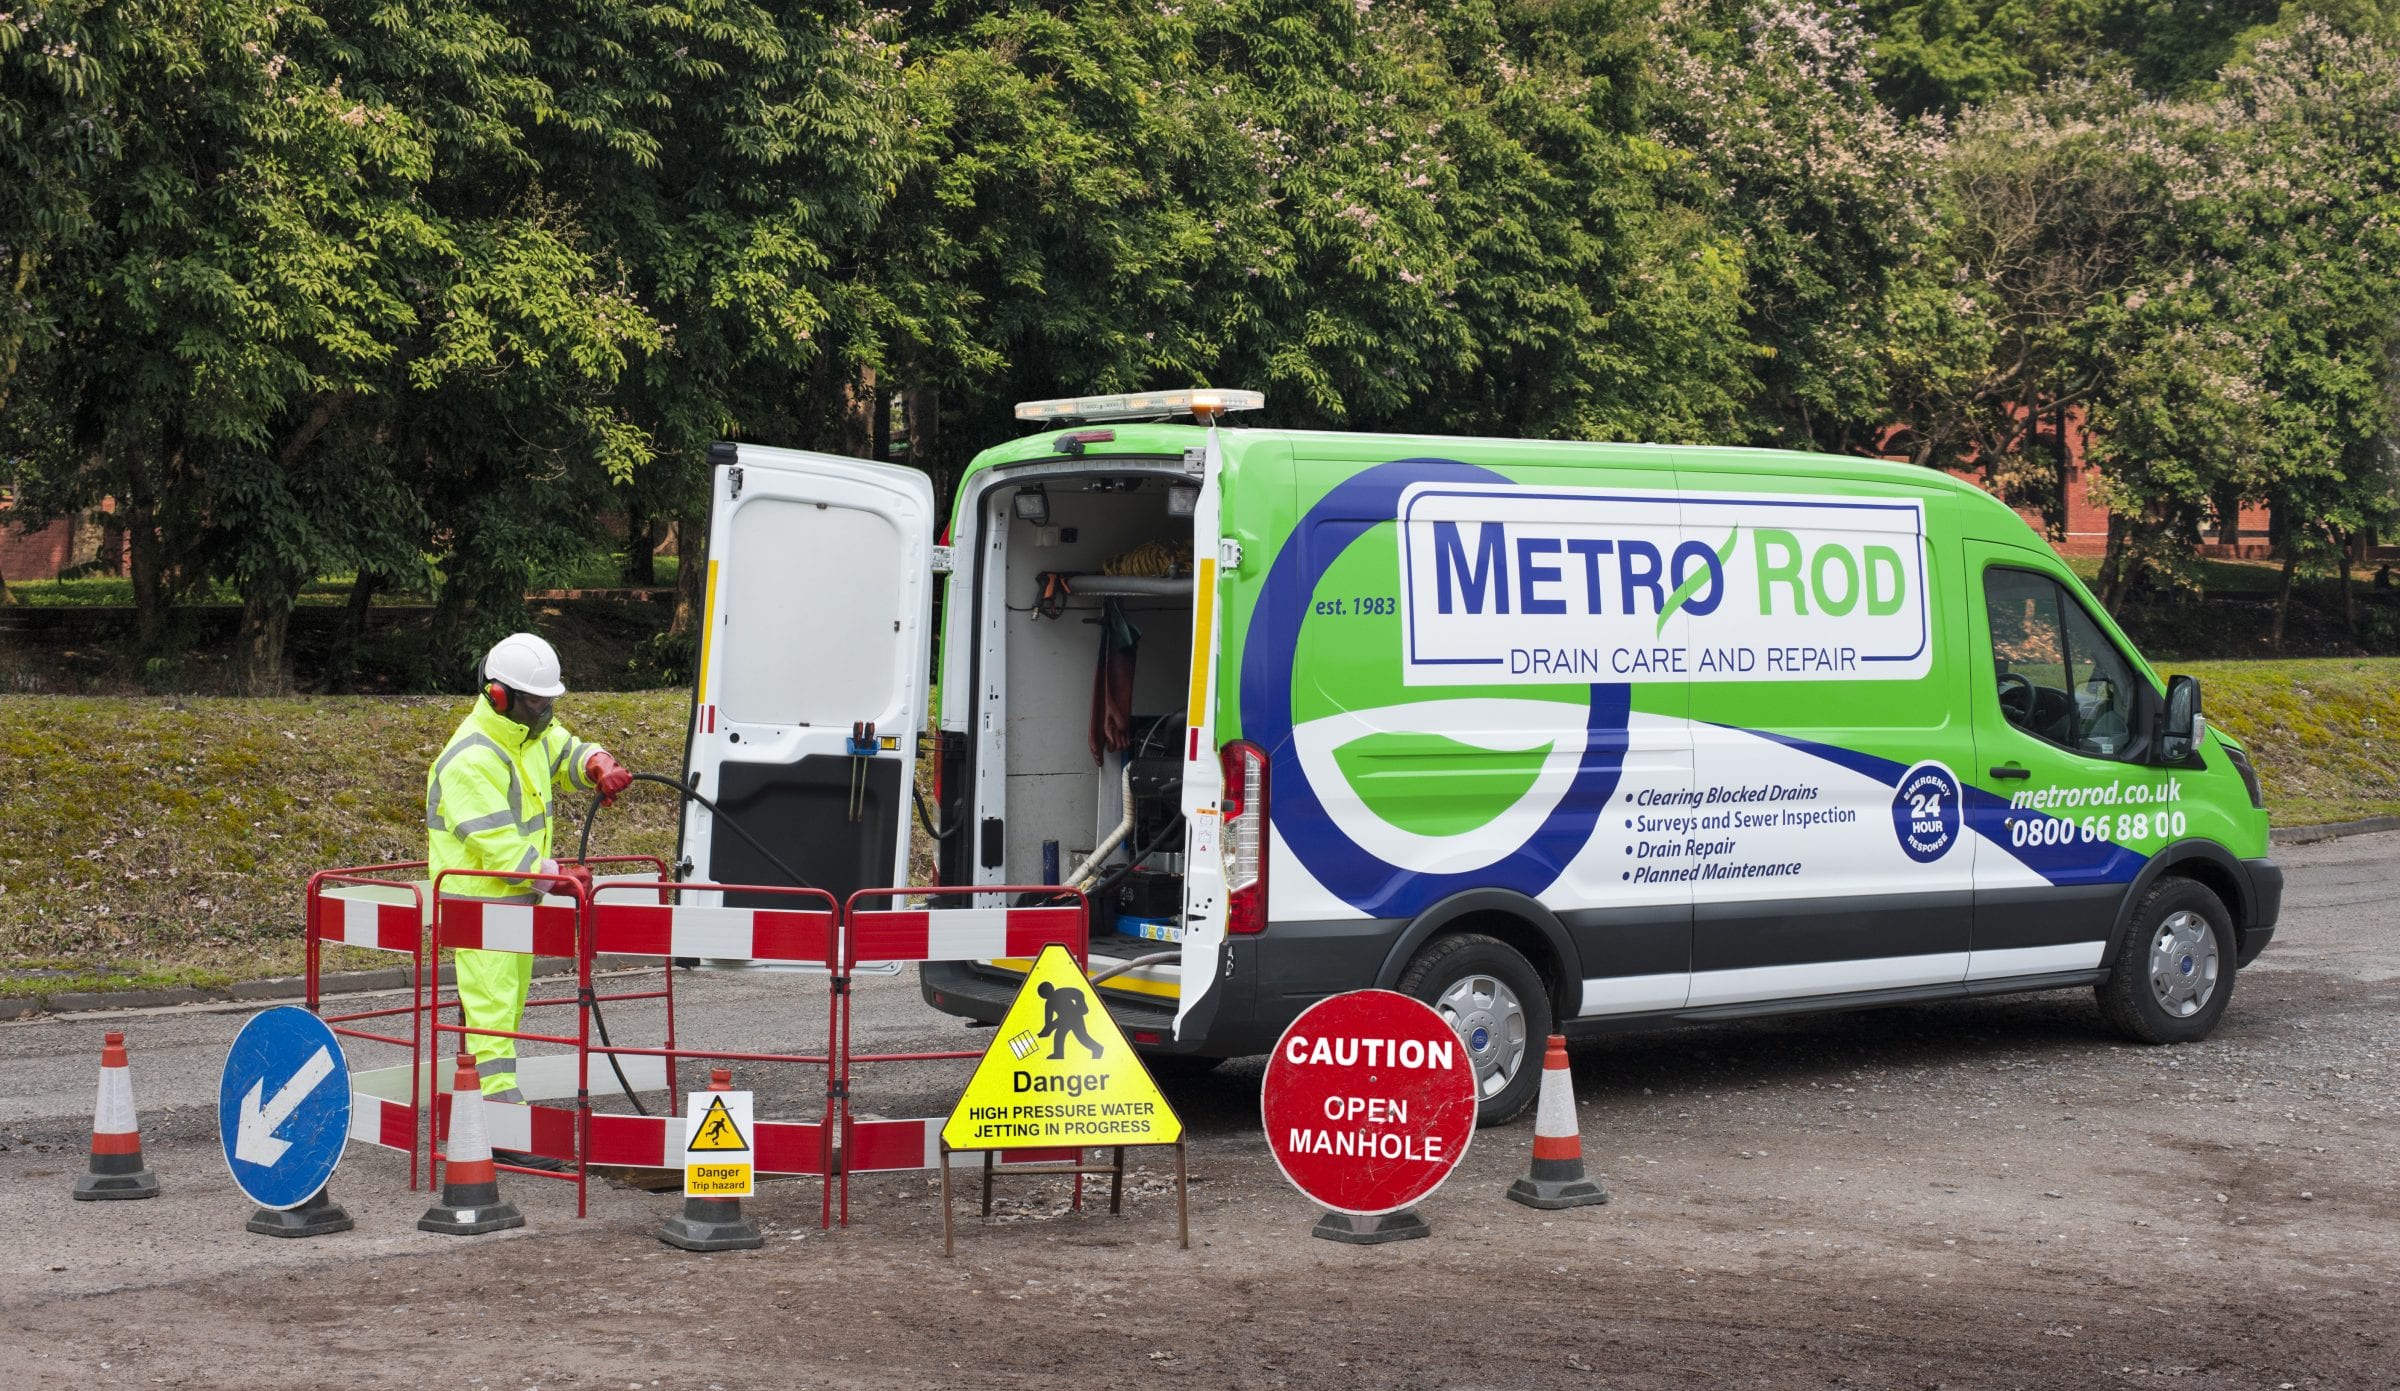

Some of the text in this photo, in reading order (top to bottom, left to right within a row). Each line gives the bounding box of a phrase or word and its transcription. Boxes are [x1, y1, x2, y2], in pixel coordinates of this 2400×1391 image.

[1433, 521, 1906, 617] METRO ROD
[1316, 597, 1396, 615] est. 1983
[1511, 647, 1857, 675] DRAIN CARE AND REPAIR
[1638, 784, 1818, 809] Clearing Blocked Drains
[1903, 776, 1951, 800] EMERGENCY
[2010, 777, 2182, 810] metrorod.co.uk
[1910, 794, 1940, 818] 24
[1637, 806, 1856, 835] Surveys and Sewer Inspection
[1912, 821, 1944, 834] HOUR
[2012, 811, 2186, 848] 0800 66 88 00
[1637, 837, 1736, 860] Drain Repair
[1908, 833, 1949, 853] RESPONSE
[1633, 860, 1802, 884] Planned Maintenance
[1286, 1036, 1453, 1070] CAUTION
[1014, 1071, 1110, 1097] Danger
[970, 1103, 1155, 1121] HIGH PRESSURE WATER
[1324, 1096, 1407, 1124] OPEN
[974, 1120, 1151, 1138] JETTING IN PROGRESS
[1289, 1128, 1444, 1162] MANHOLE
[692, 1181, 745, 1191] Trip hazard
[697, 1168, 740, 1180] Danger
